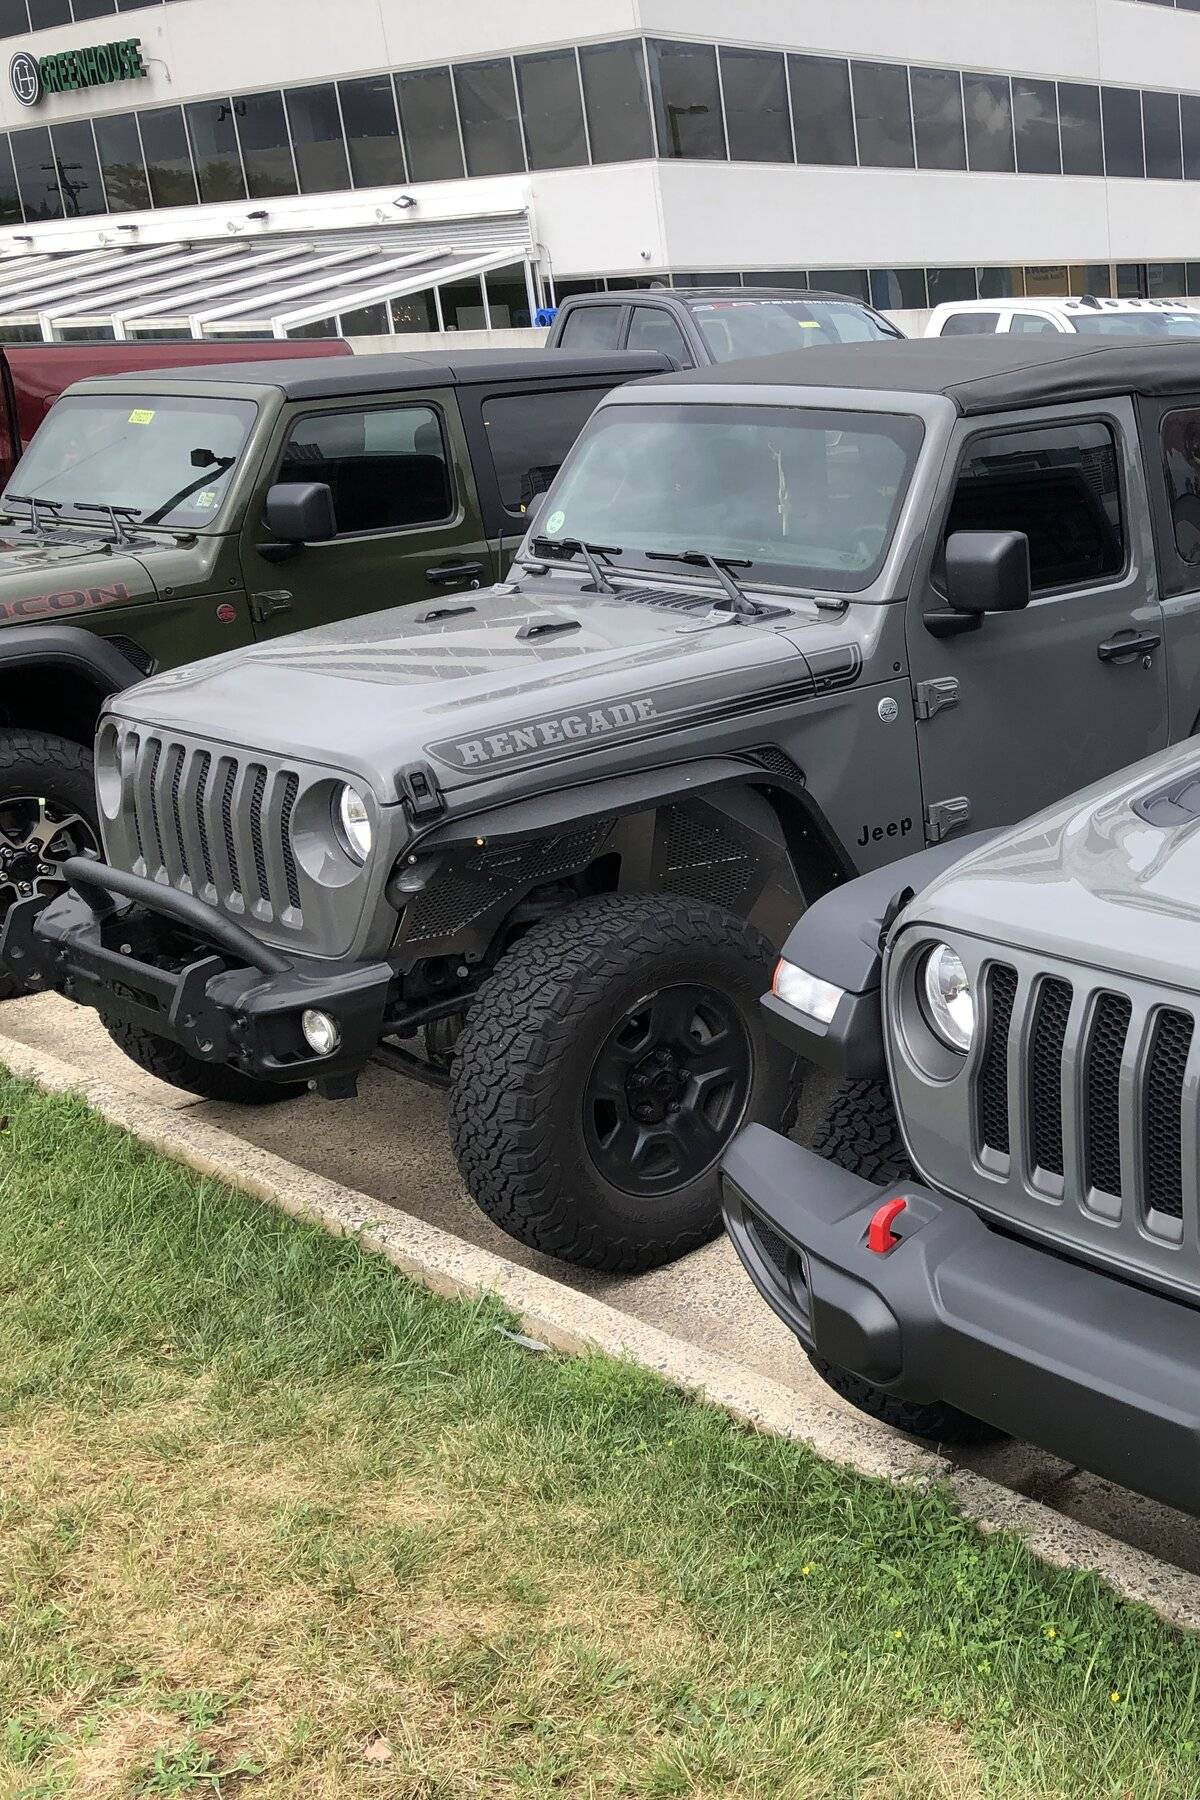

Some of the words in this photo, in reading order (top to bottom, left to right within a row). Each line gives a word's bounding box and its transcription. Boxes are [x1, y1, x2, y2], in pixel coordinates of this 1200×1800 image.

[39, 38, 146, 93] GREENHOUSE
[455, 698, 659, 766] RENEGADE
[857, 817, 913, 847] Jeep
